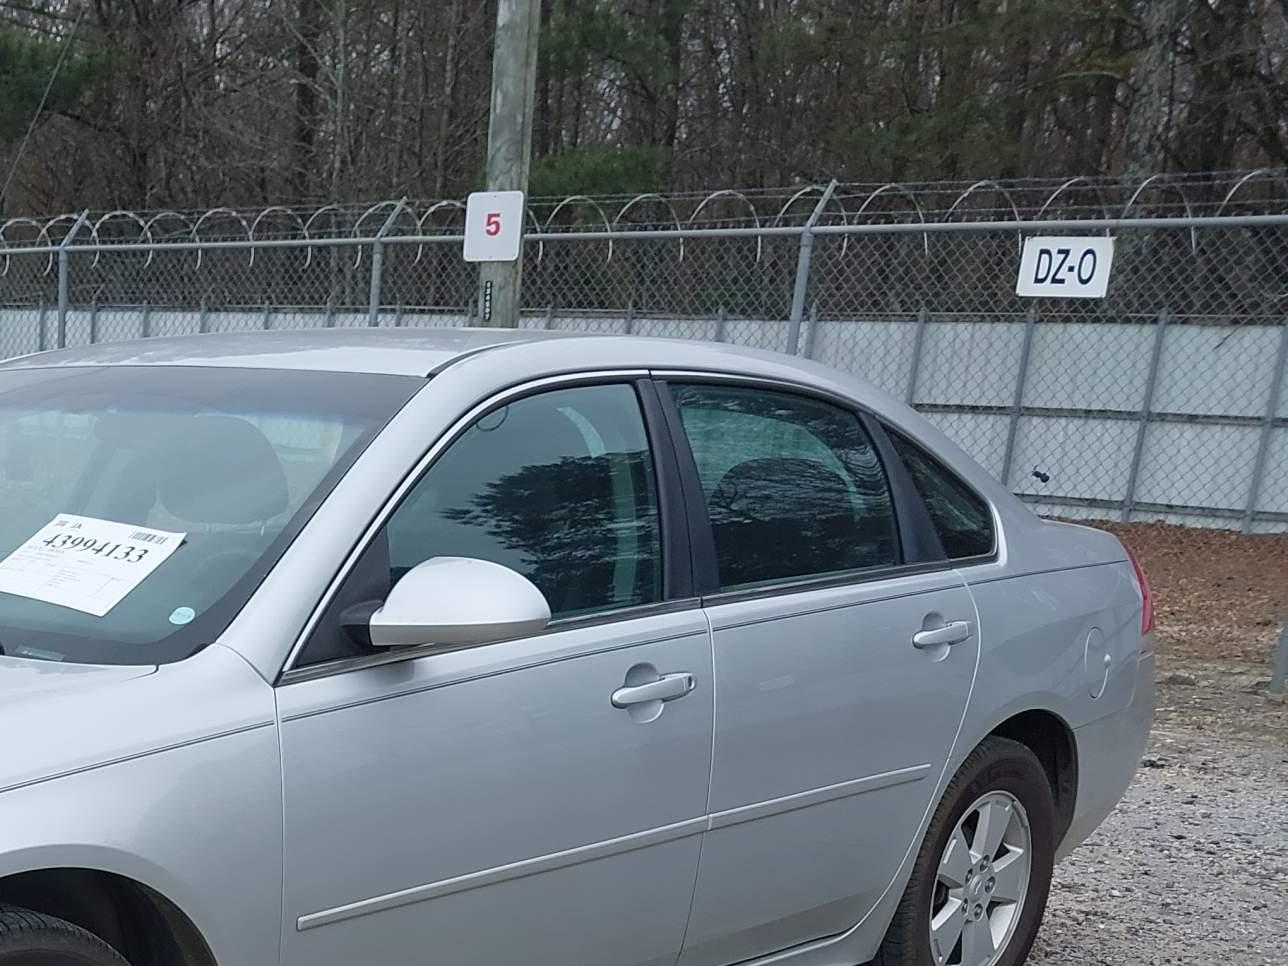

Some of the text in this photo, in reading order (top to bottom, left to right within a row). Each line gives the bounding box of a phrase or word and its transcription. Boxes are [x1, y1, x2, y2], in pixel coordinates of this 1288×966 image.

[486, 213, 501, 236] 5
[1033, 248, 1097, 285] DZ-O
[43, 533, 149, 563] 43994133
